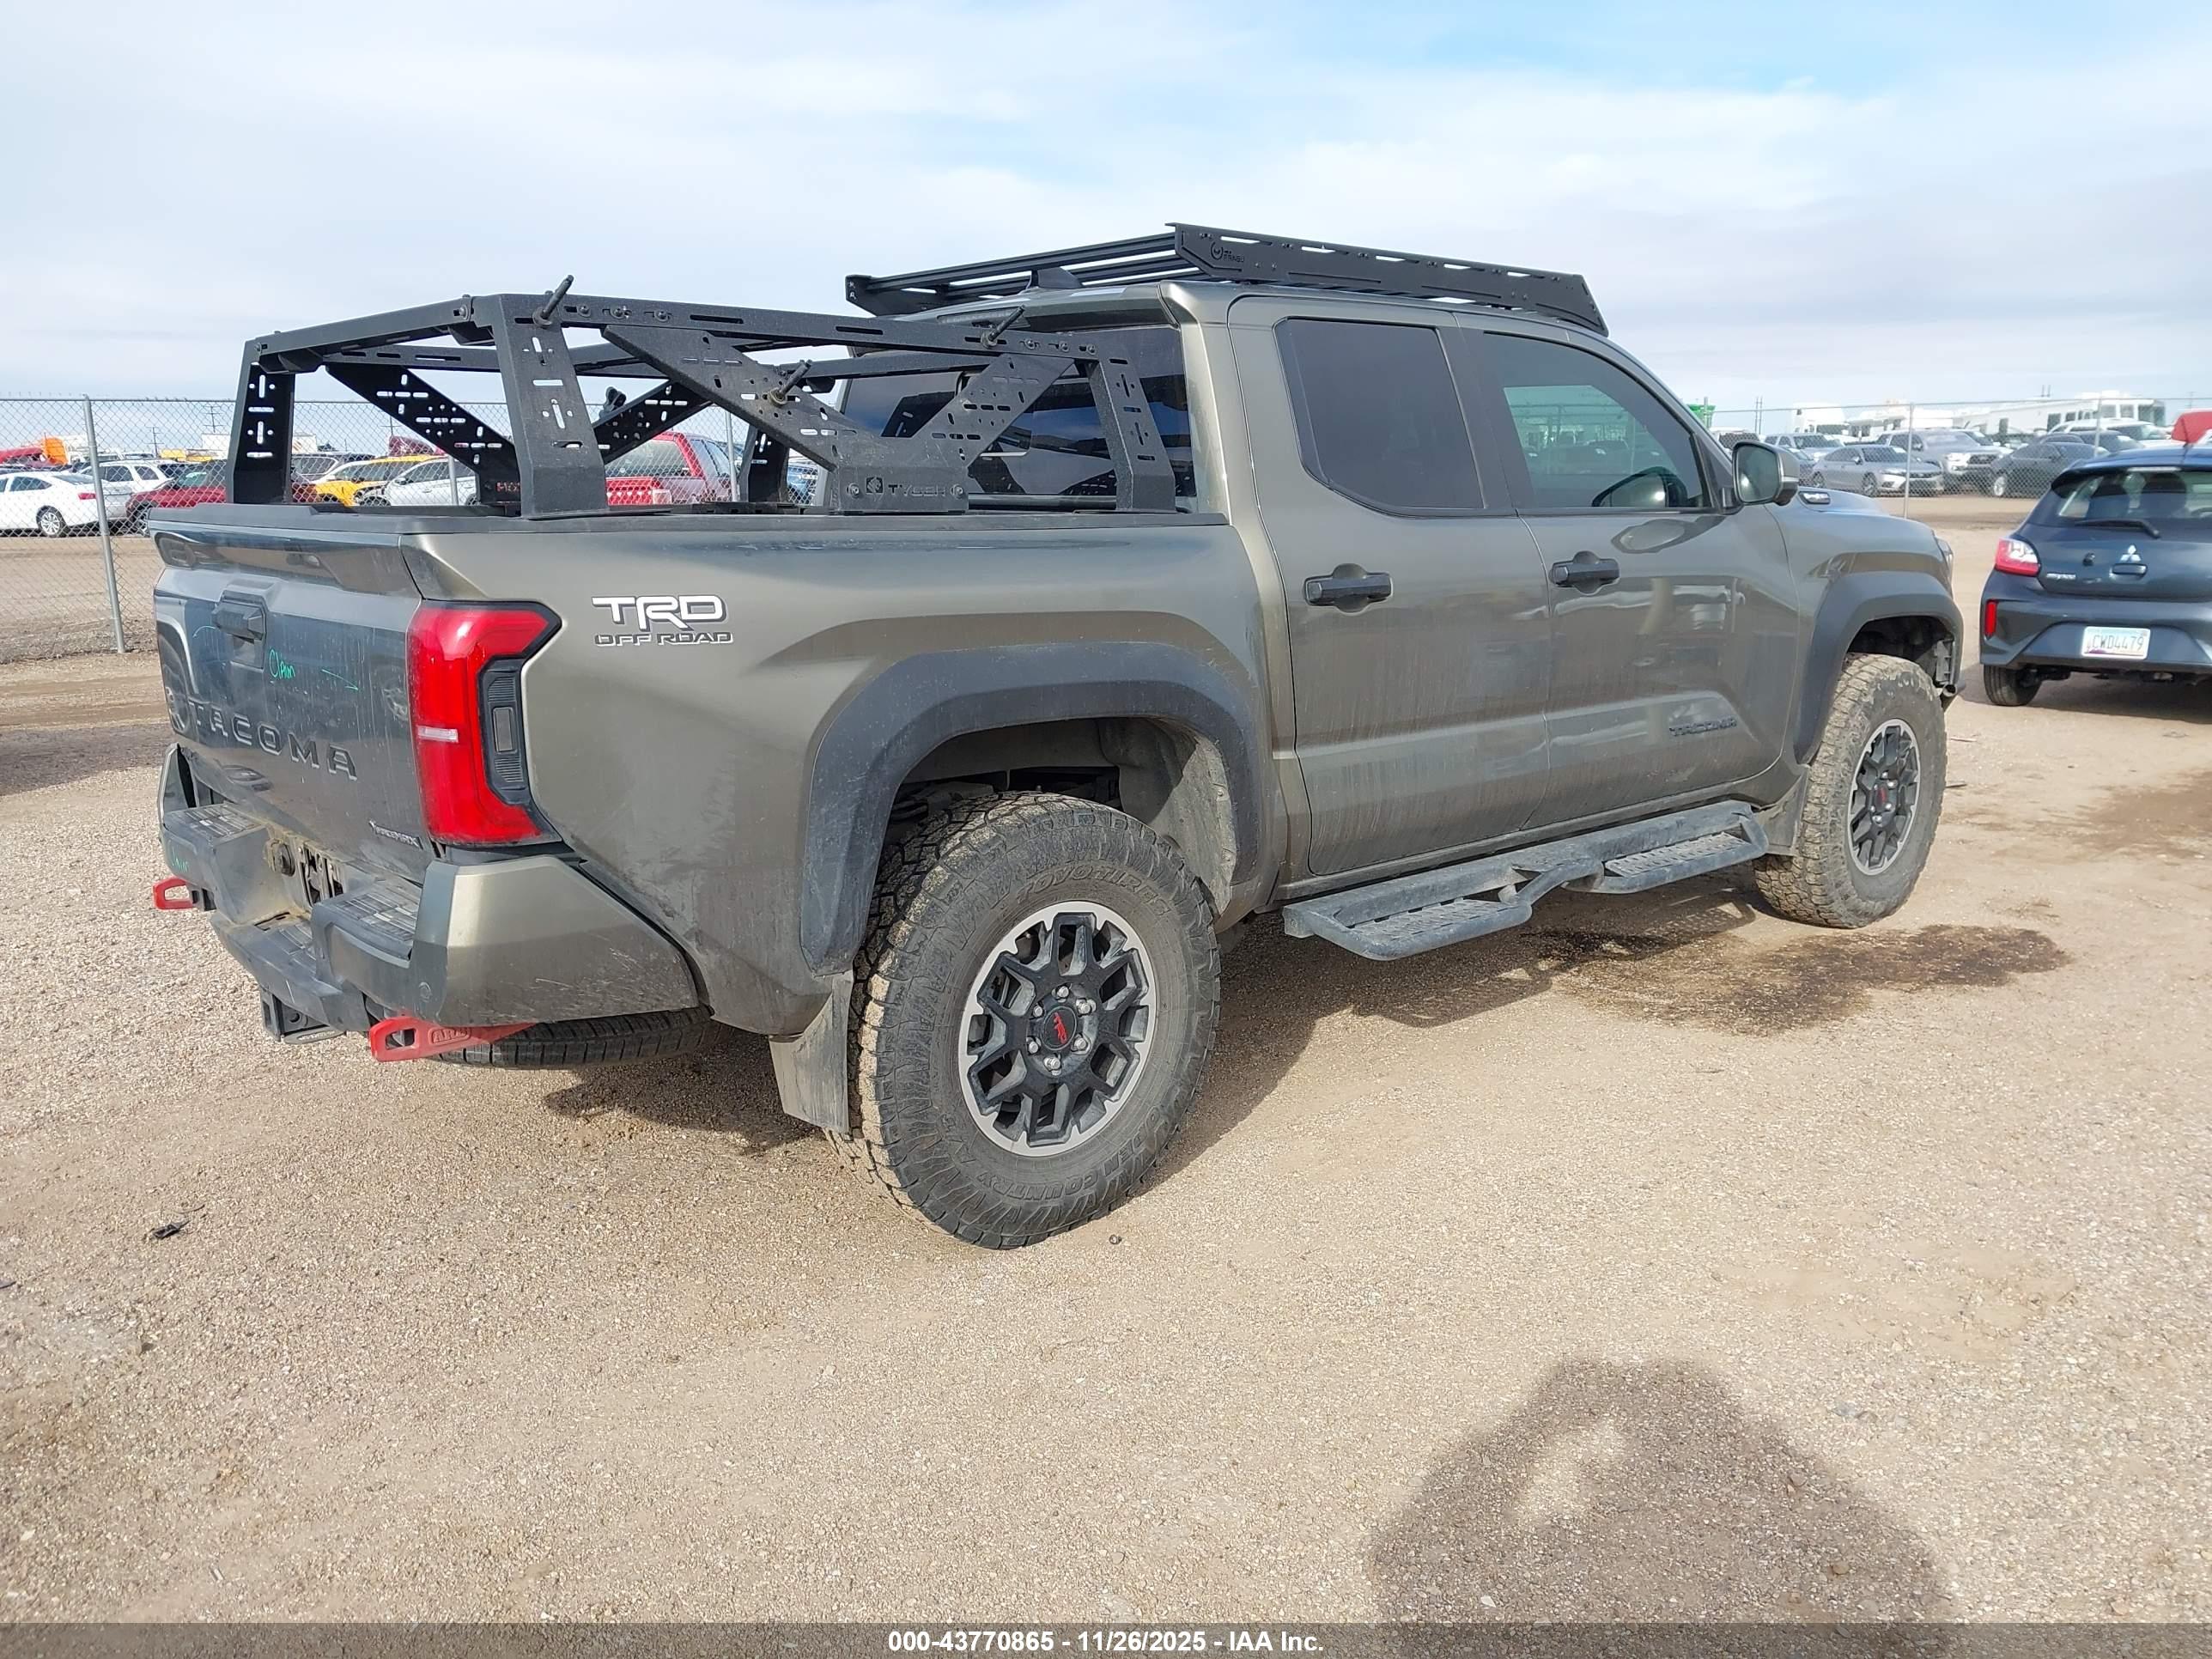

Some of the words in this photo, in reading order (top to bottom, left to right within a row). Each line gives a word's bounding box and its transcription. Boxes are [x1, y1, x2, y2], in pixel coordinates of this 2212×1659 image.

[591, 594, 727, 632] TRD
[594, 634, 653, 647] OFF
[656, 631, 733, 646] ROAD
[187, 697, 359, 781] TACOMA
